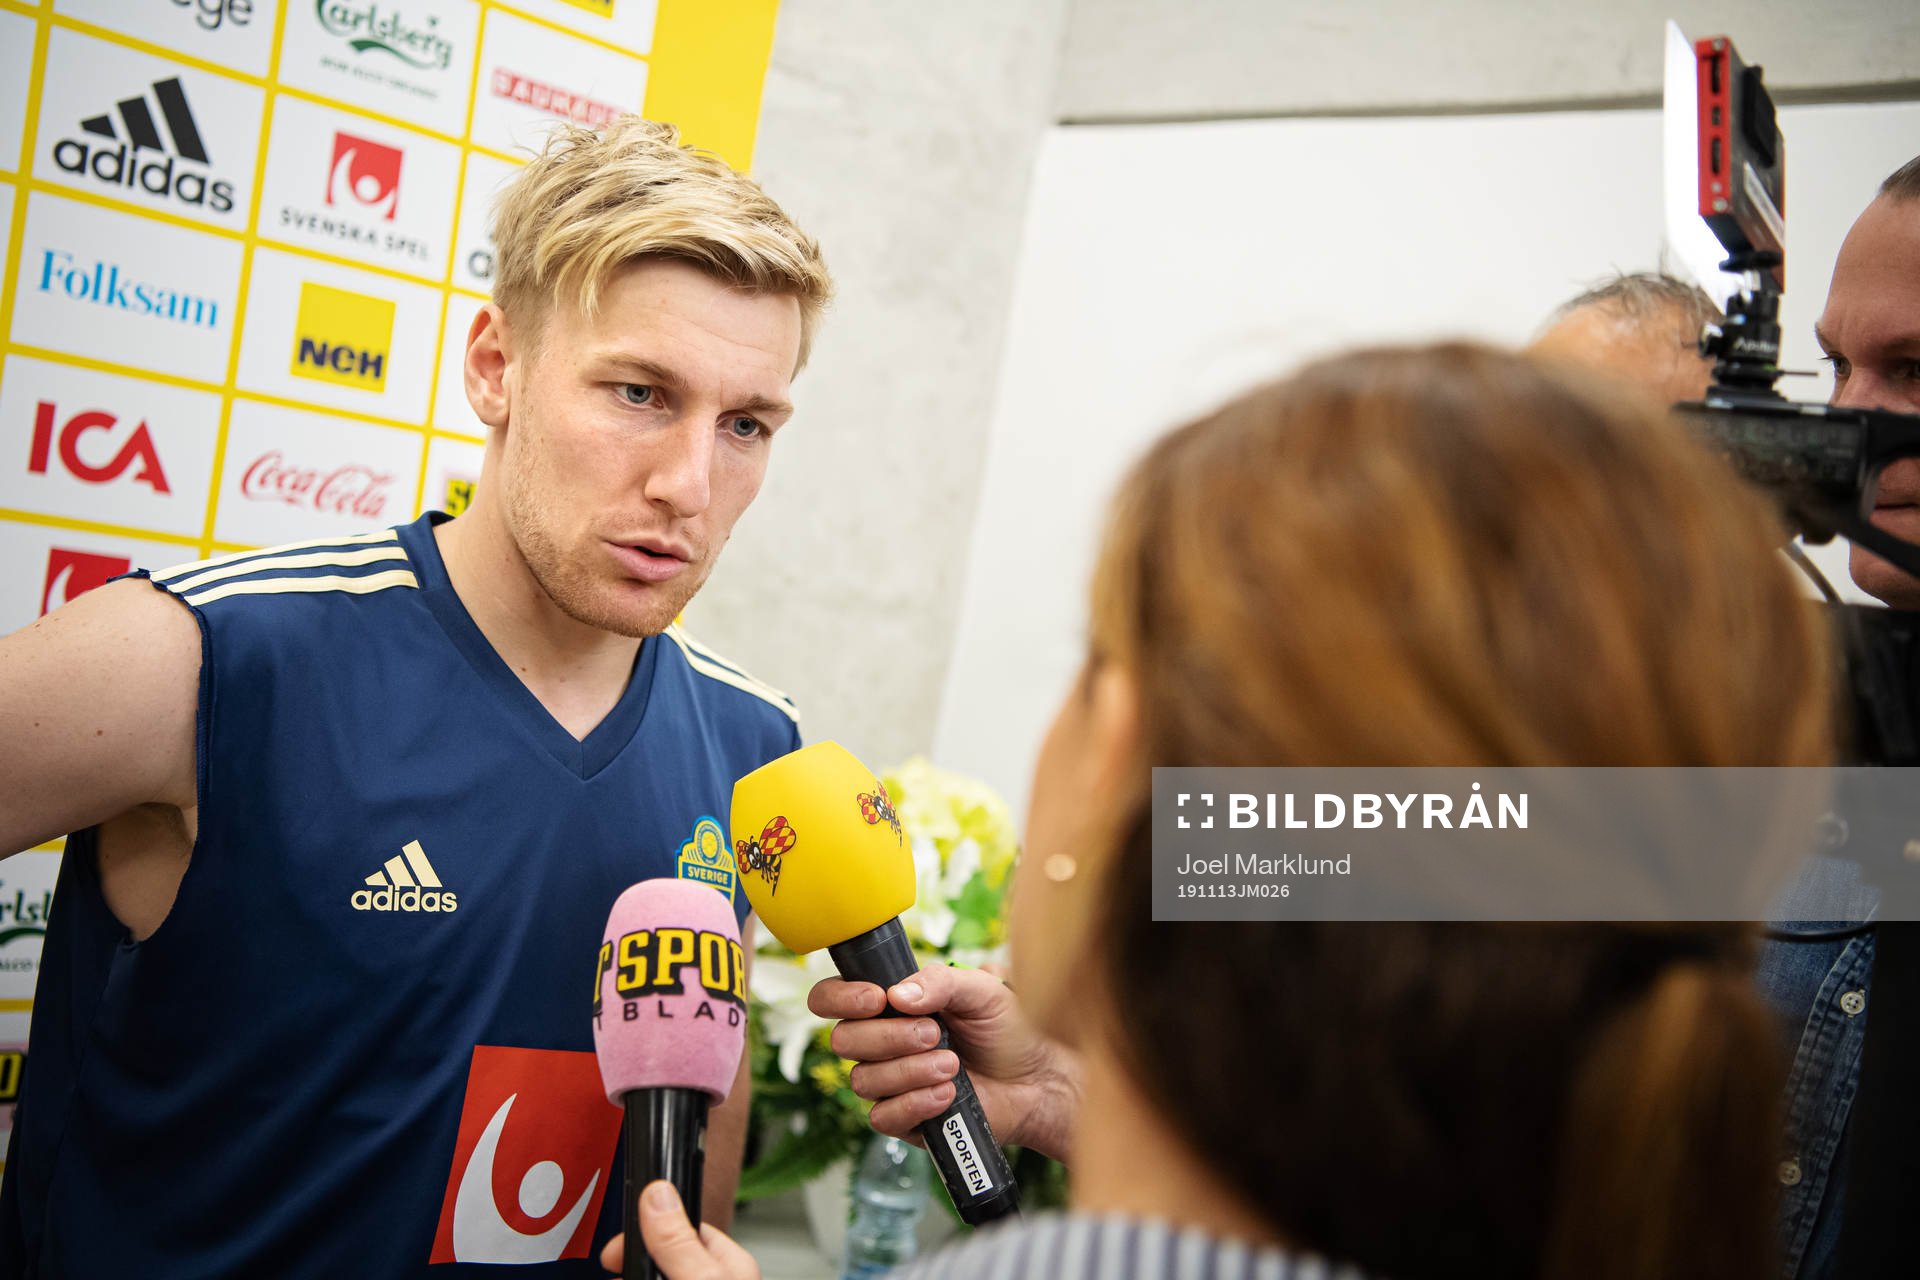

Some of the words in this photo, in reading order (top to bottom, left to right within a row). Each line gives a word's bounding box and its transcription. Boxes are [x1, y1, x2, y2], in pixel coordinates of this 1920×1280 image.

[316, 0, 454, 70] Carlsberg
[53, 138, 235, 214] adidas
[280, 206, 378, 245] SVENSKA
[384, 231, 430, 261] SPEL
[39, 248, 219, 328] Folksam
[27, 400, 172, 497] ICA
[351, 885, 458, 913] adidas
[687, 865, 729, 885] SVERIGE
[946, 1119, 986, 1192] SPORTEN
